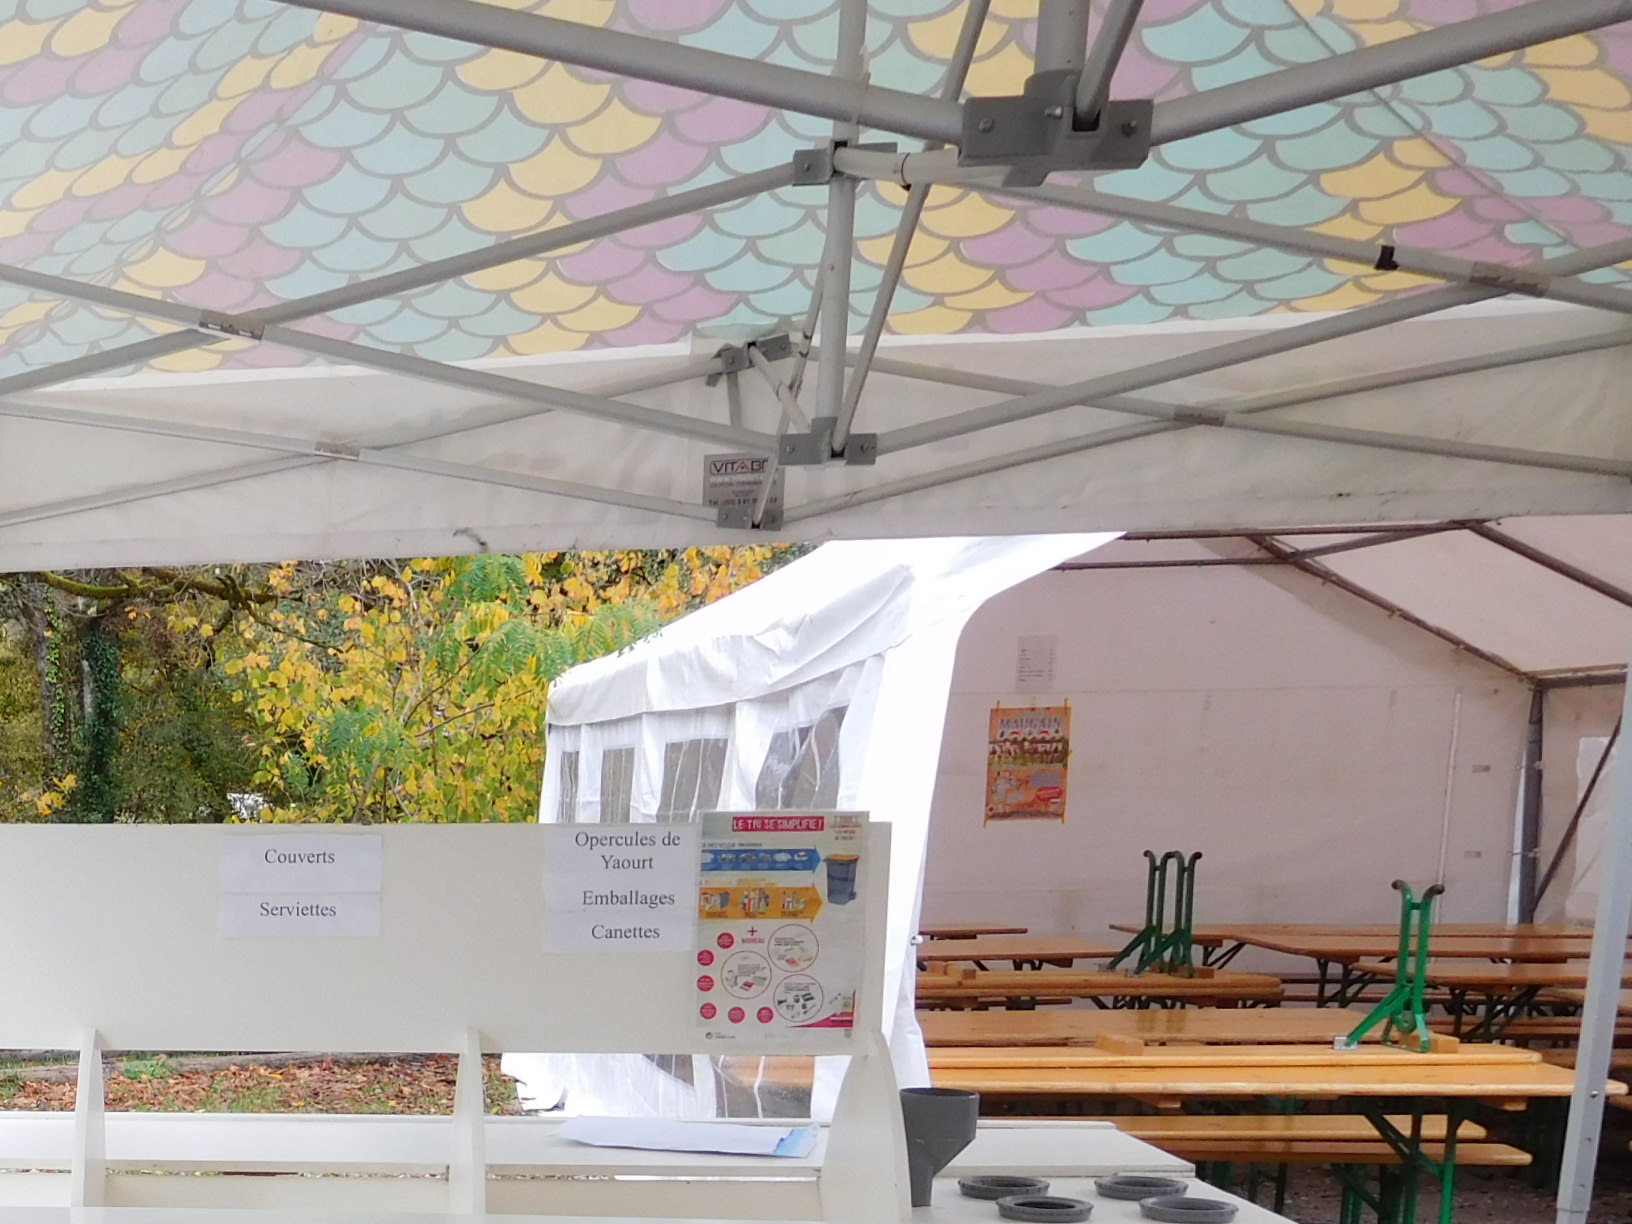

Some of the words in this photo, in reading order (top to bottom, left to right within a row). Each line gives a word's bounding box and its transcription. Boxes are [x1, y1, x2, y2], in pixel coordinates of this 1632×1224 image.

[733, 819, 745, 830] LE
[747, 819, 762, 830] TRI
[763, 819, 776, 830] SE
[776, 818, 817, 830] SIMPLIFIE
[574, 831, 657, 849] Opercules
[661, 830, 681, 846] de
[264, 848, 336, 864] Couverts
[600, 854, 654, 870] Yaourt
[582, 890, 676, 909] Emballages
[259, 901, 337, 917] Serviettes
[591, 924, 661, 940] Canettes
